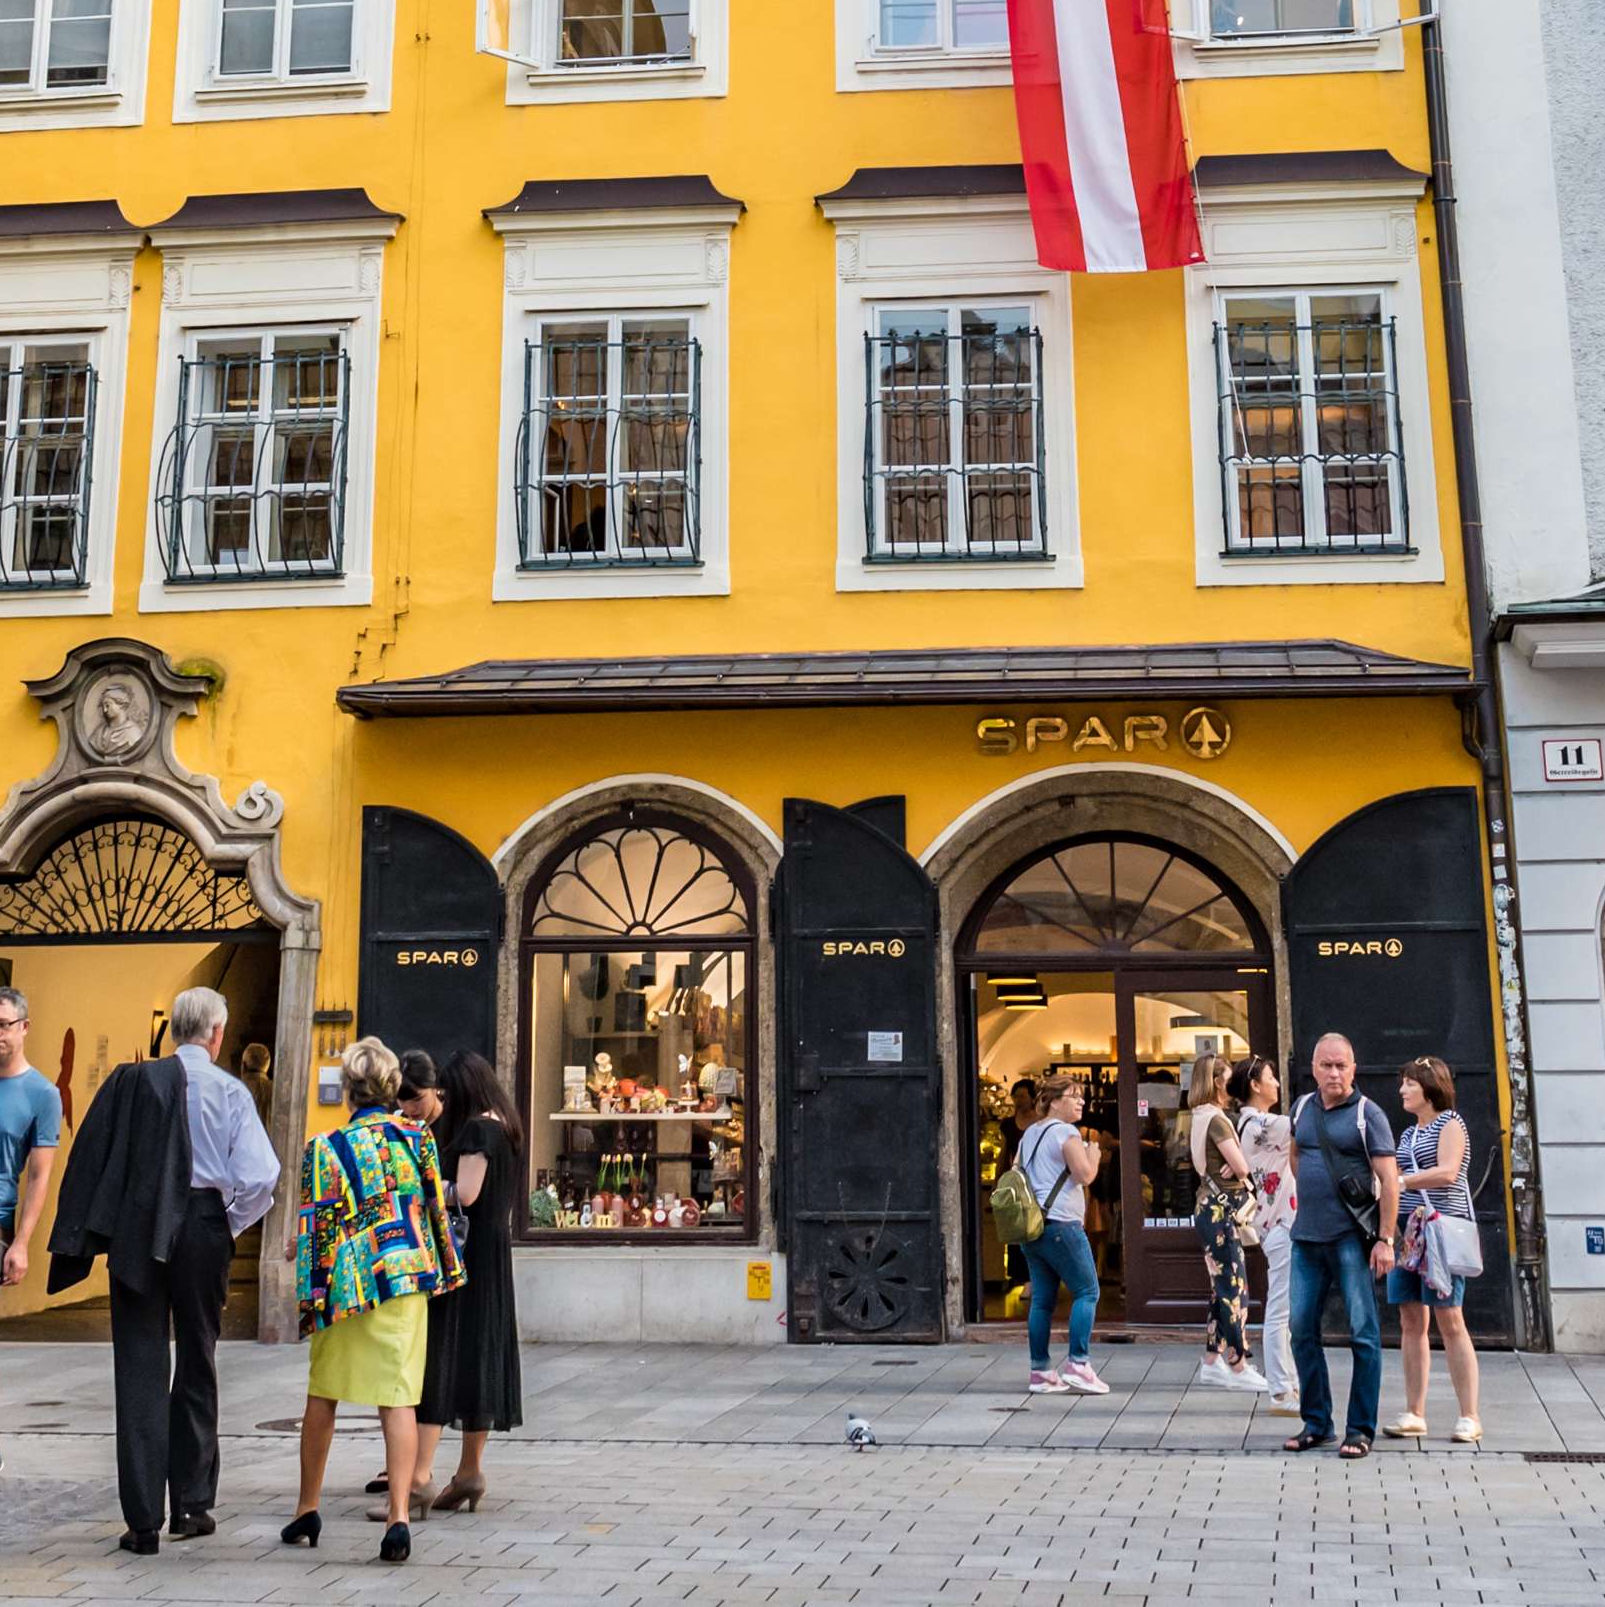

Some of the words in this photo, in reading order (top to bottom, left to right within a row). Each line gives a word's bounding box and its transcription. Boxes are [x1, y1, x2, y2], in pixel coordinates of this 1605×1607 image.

[976, 715, 1168, 755] SPAR
[1558, 745, 1586, 766] 11
[822, 941, 885, 955] SPAR
[1318, 941, 1383, 956] SPAR
[397, 951, 459, 965] SPAR
